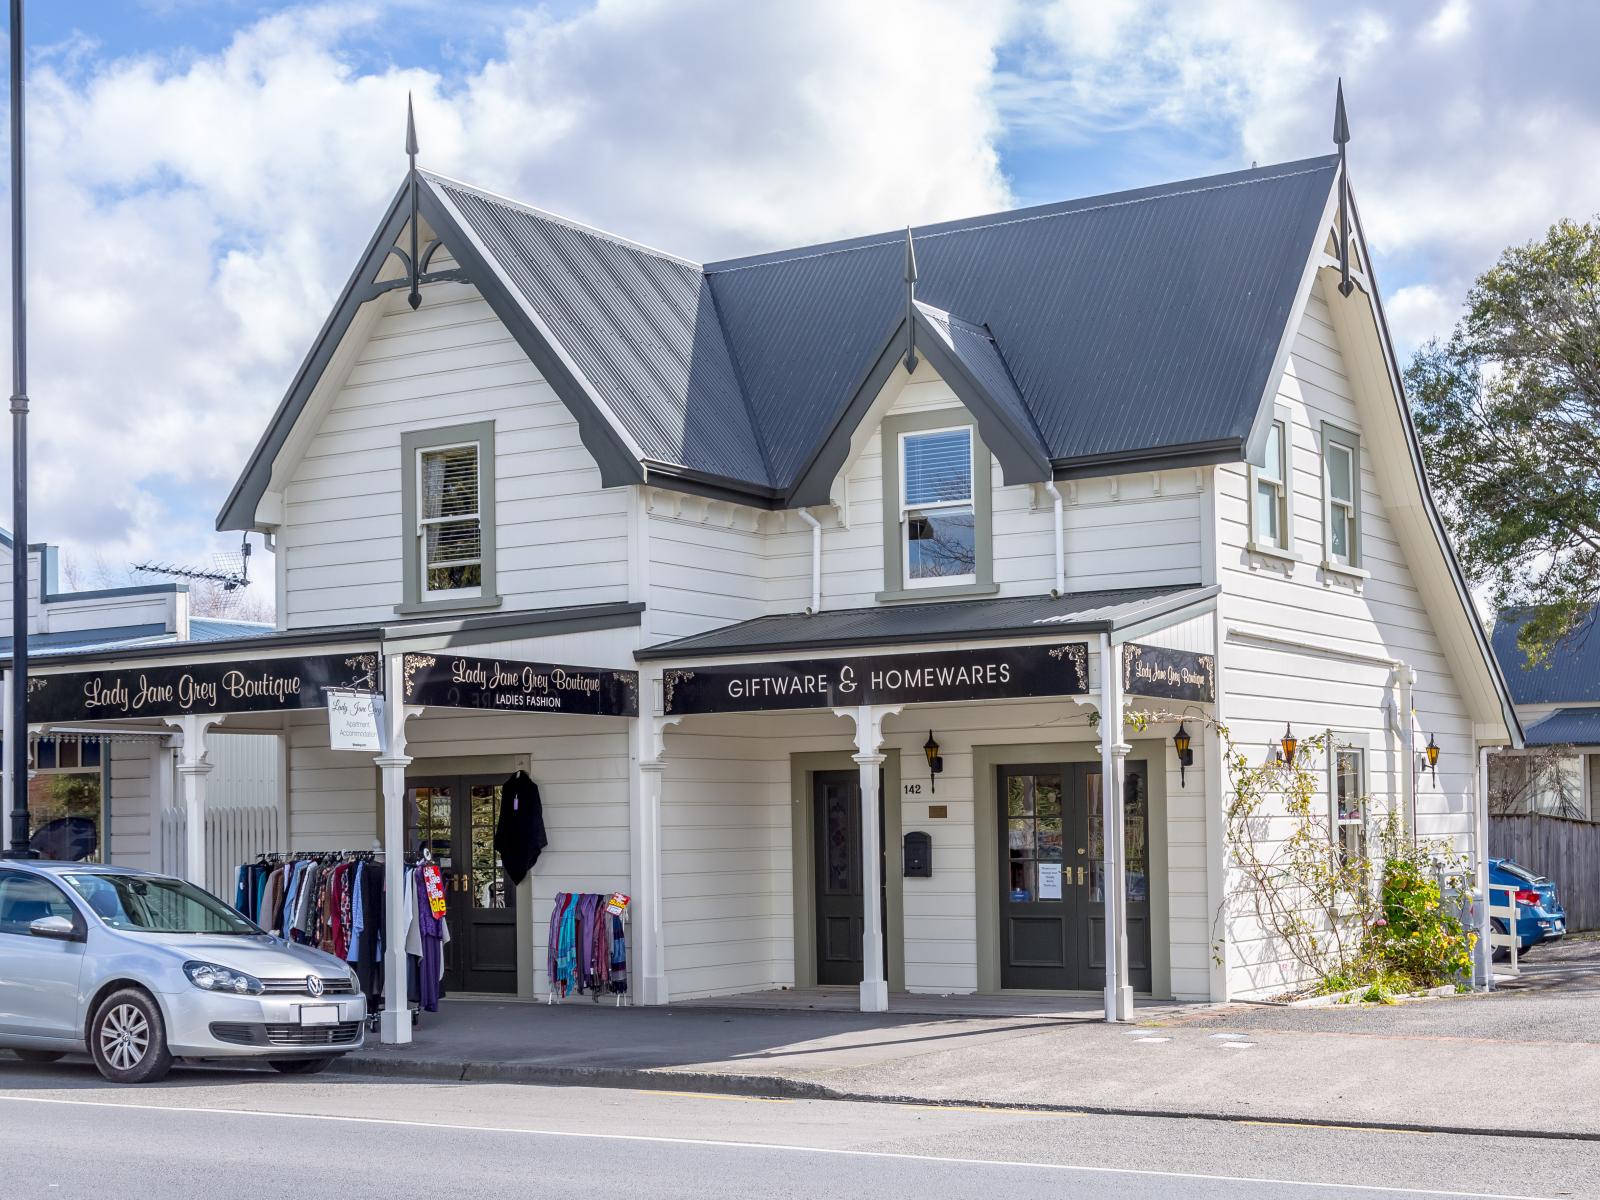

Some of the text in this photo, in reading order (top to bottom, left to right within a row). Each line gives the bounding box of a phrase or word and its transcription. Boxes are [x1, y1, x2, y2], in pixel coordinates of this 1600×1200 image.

[452, 659, 600, 696] Lady Jane Grey Boutique
[728, 663, 1010, 698] GIFTWARE & HOMEWARES
[1135, 660, 1205, 688] Lady Jane Grey Boutique
[84, 670, 301, 711] Lady Jane Grey Boutique
[495, 694, 524, 706] LADIES
[526, 695, 561, 708] FASHION
[331, 699, 348, 714] Lady
[904, 784, 921, 794] 142
